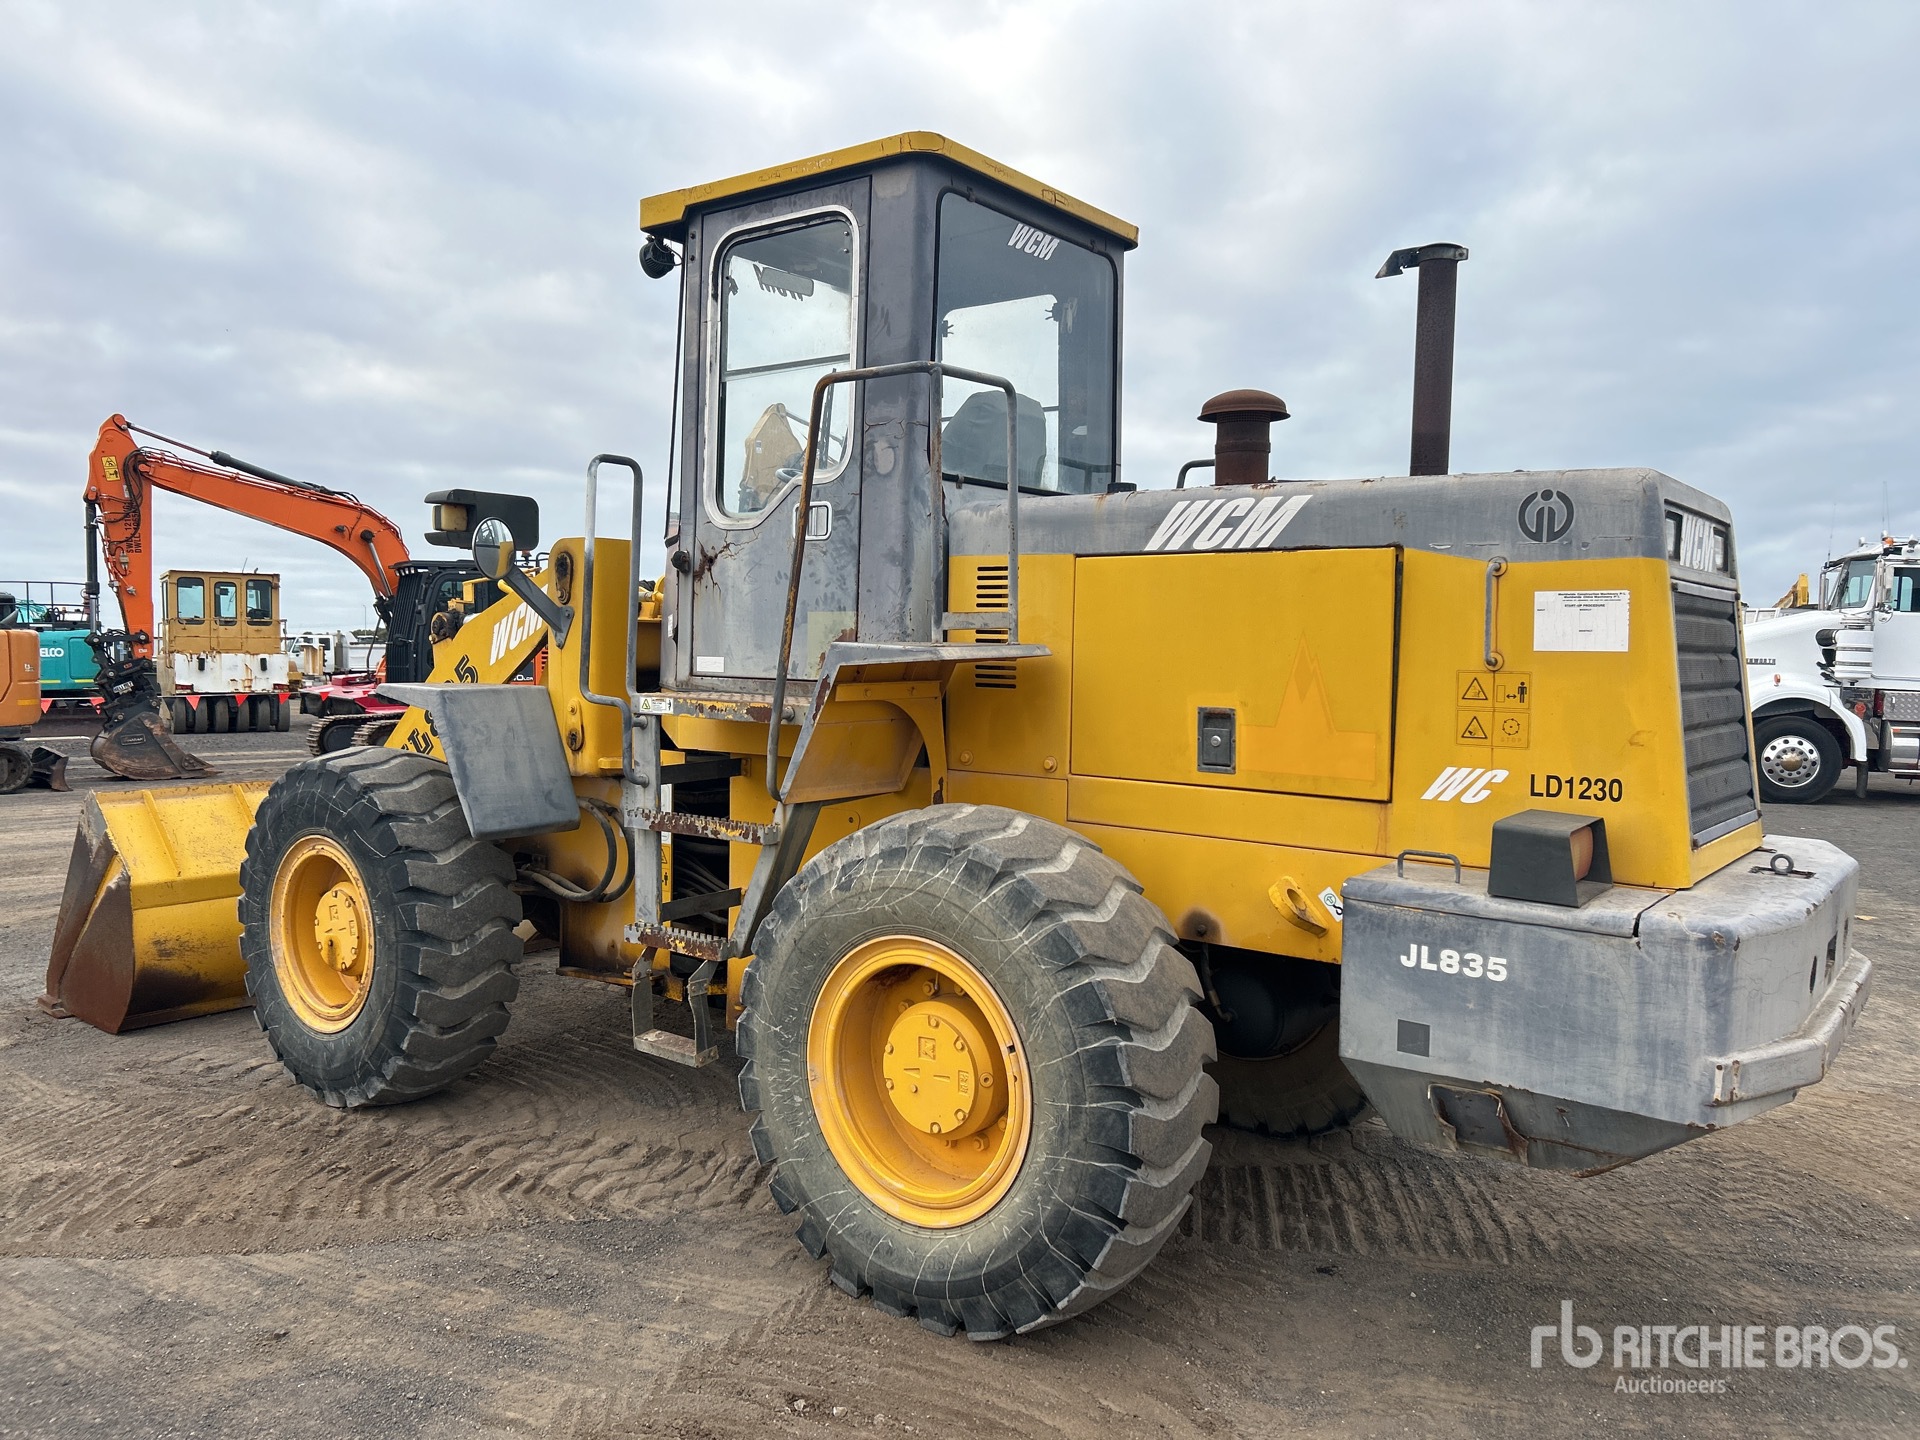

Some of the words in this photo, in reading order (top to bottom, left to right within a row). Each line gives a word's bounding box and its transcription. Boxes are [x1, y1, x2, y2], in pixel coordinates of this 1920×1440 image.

[1007, 223, 1060, 261] WCM
[1143, 494, 1314, 551] WCM
[1680, 513, 1714, 574] WCM
[1420, 766, 1509, 804] WC
[1530, 773, 1624, 803] LD1230
[1400, 943, 1508, 982] JL835
